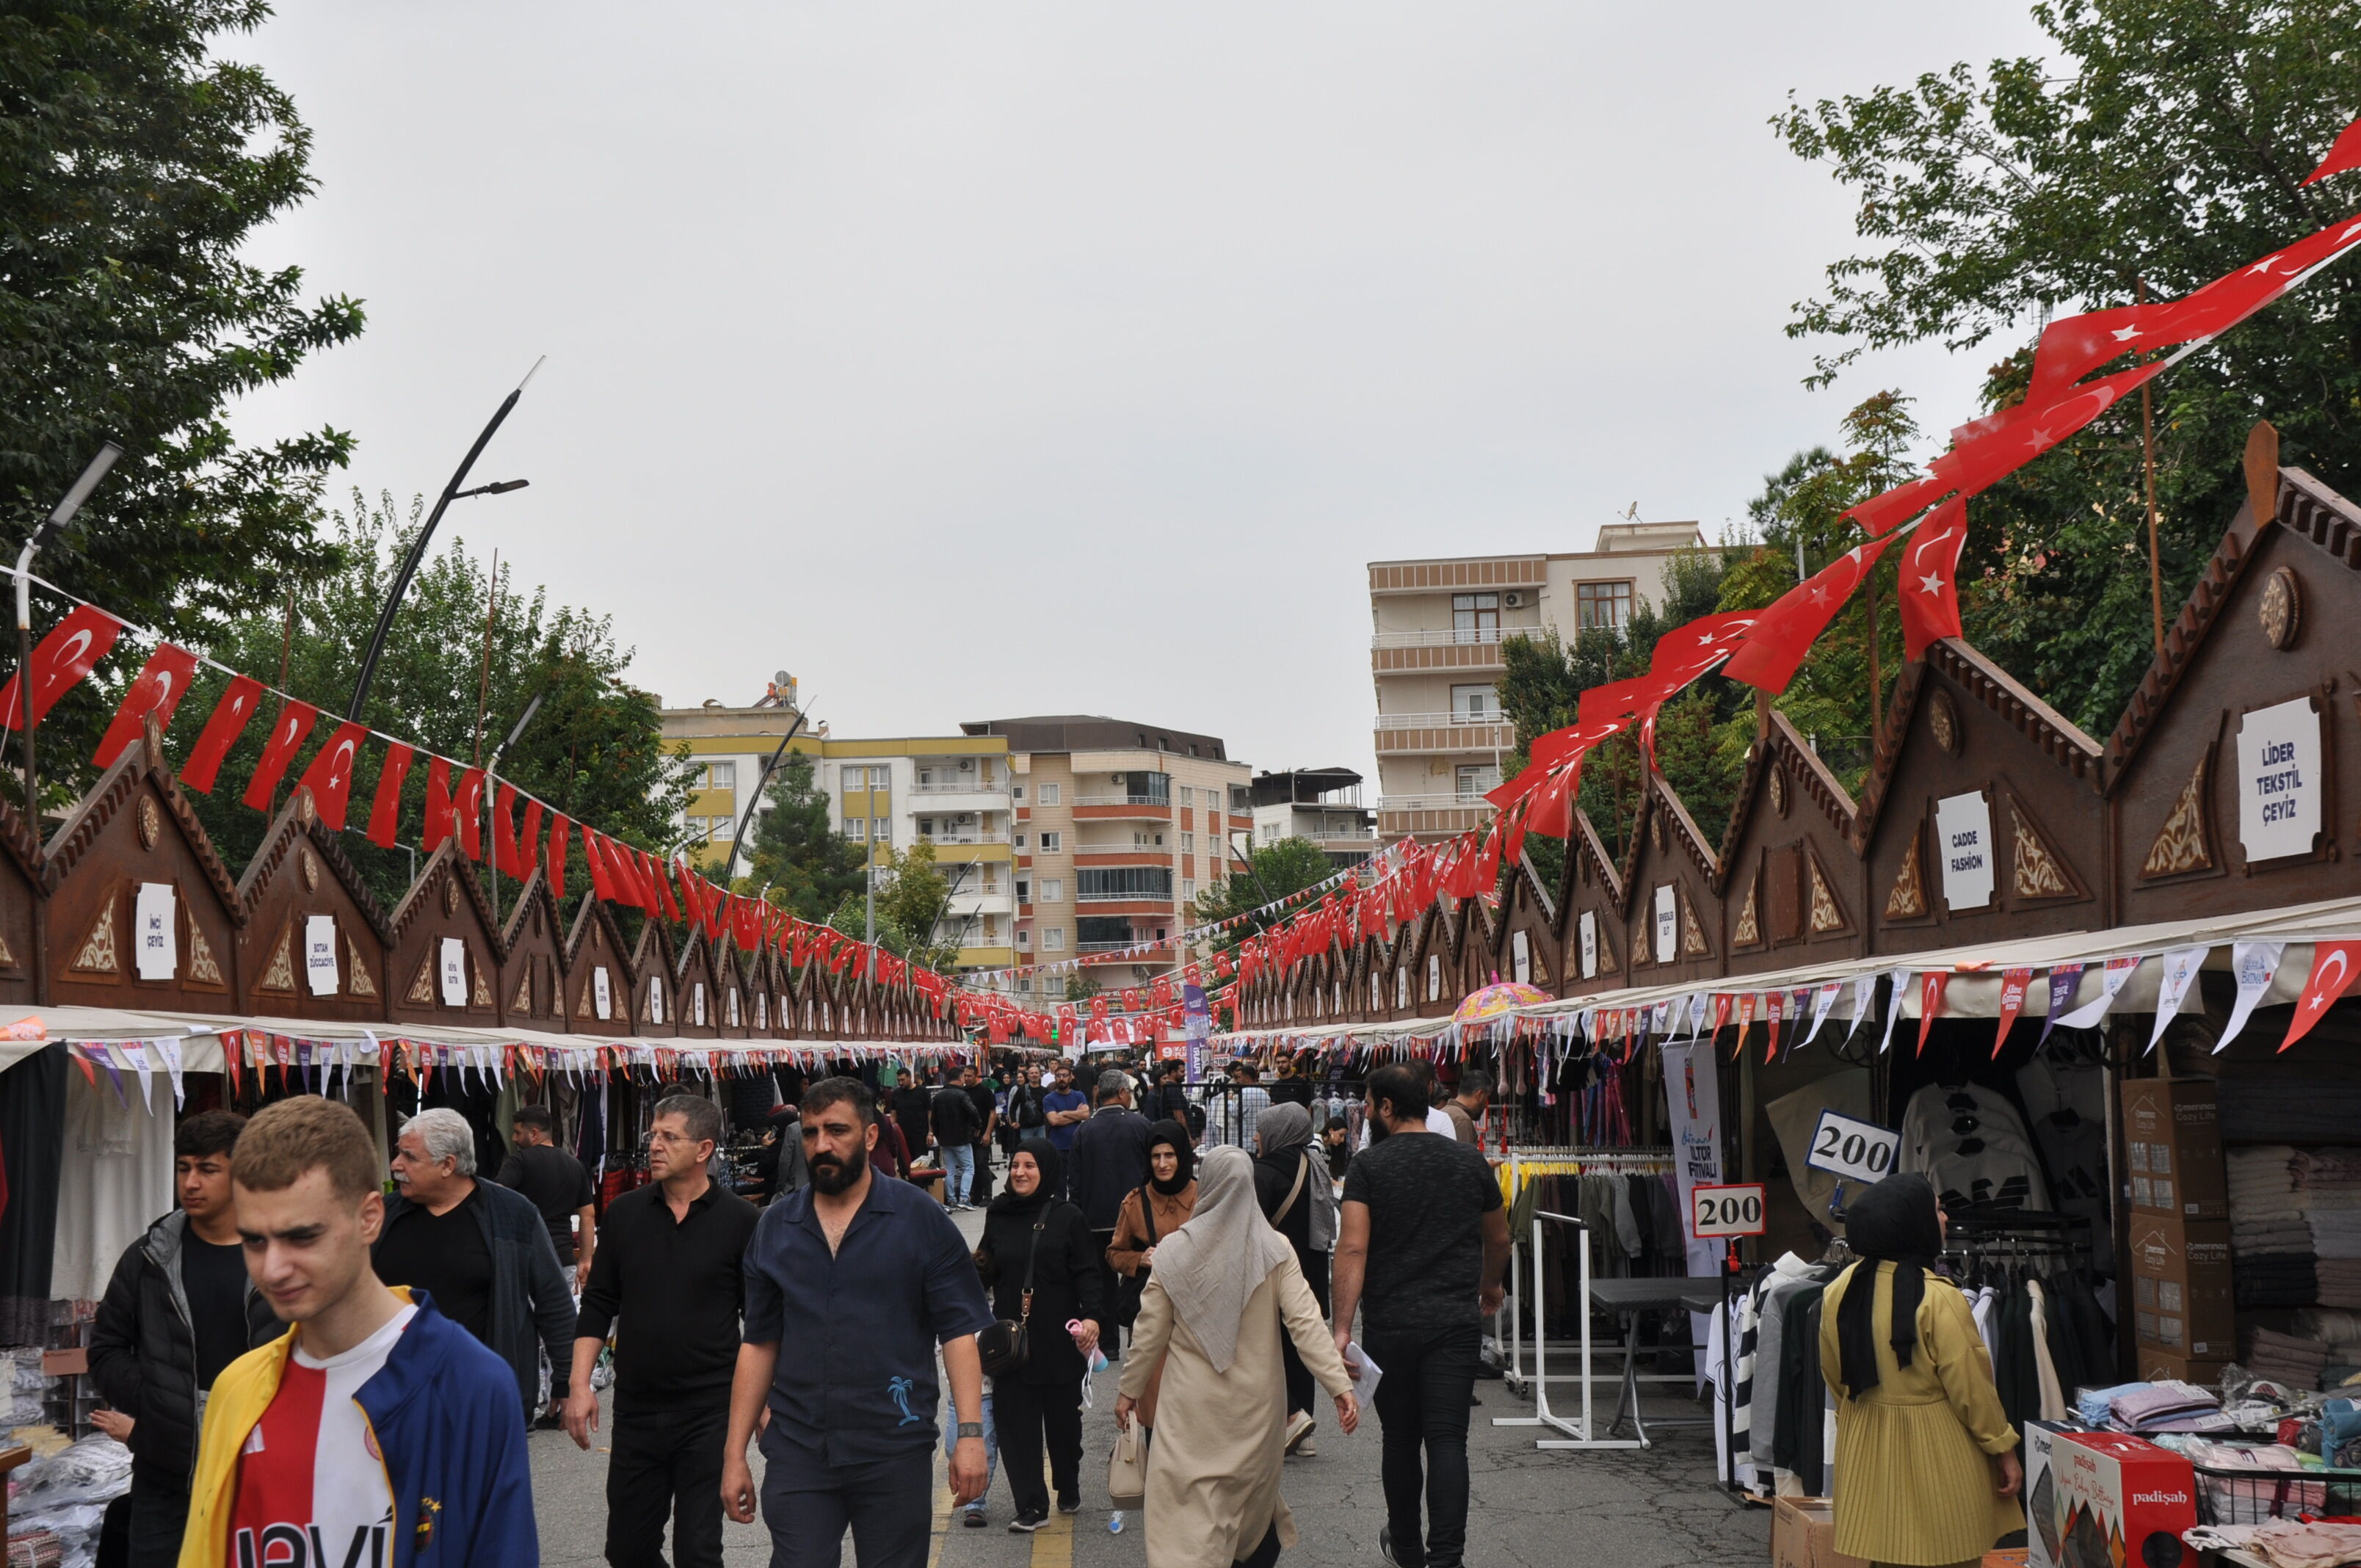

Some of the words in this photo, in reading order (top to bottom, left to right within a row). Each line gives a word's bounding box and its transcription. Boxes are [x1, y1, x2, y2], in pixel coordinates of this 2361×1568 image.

[2262, 741, 2294, 766] LİDER
[2256, 763, 2302, 796] TEKSTİL
[2263, 794, 2296, 827] ÇEYİZ
[1951, 830, 1978, 848] CADDE
[1951, 851, 1982, 873] FASHİON
[149, 913, 162, 929] İNCİ
[147, 932, 164, 949] ÇEYİZ
[313, 943, 328, 953] BOTAN
[309, 954, 334, 968] ZÜCCACİYE
[1214, 1057, 1228, 1066] 300
[2175, 1112, 2197, 1122] Cozy
[2199, 1111, 2216, 1119] Life
[1814, 1125, 1891, 1173] 200
[1698, 1196, 1761, 1226] 200
[2187, 1252, 2208, 1262] Cozy
[2211, 1251, 2227, 1260] Life
[2073, 1454, 2097, 1474] padişah
[2132, 1490, 2188, 1506] padişah
